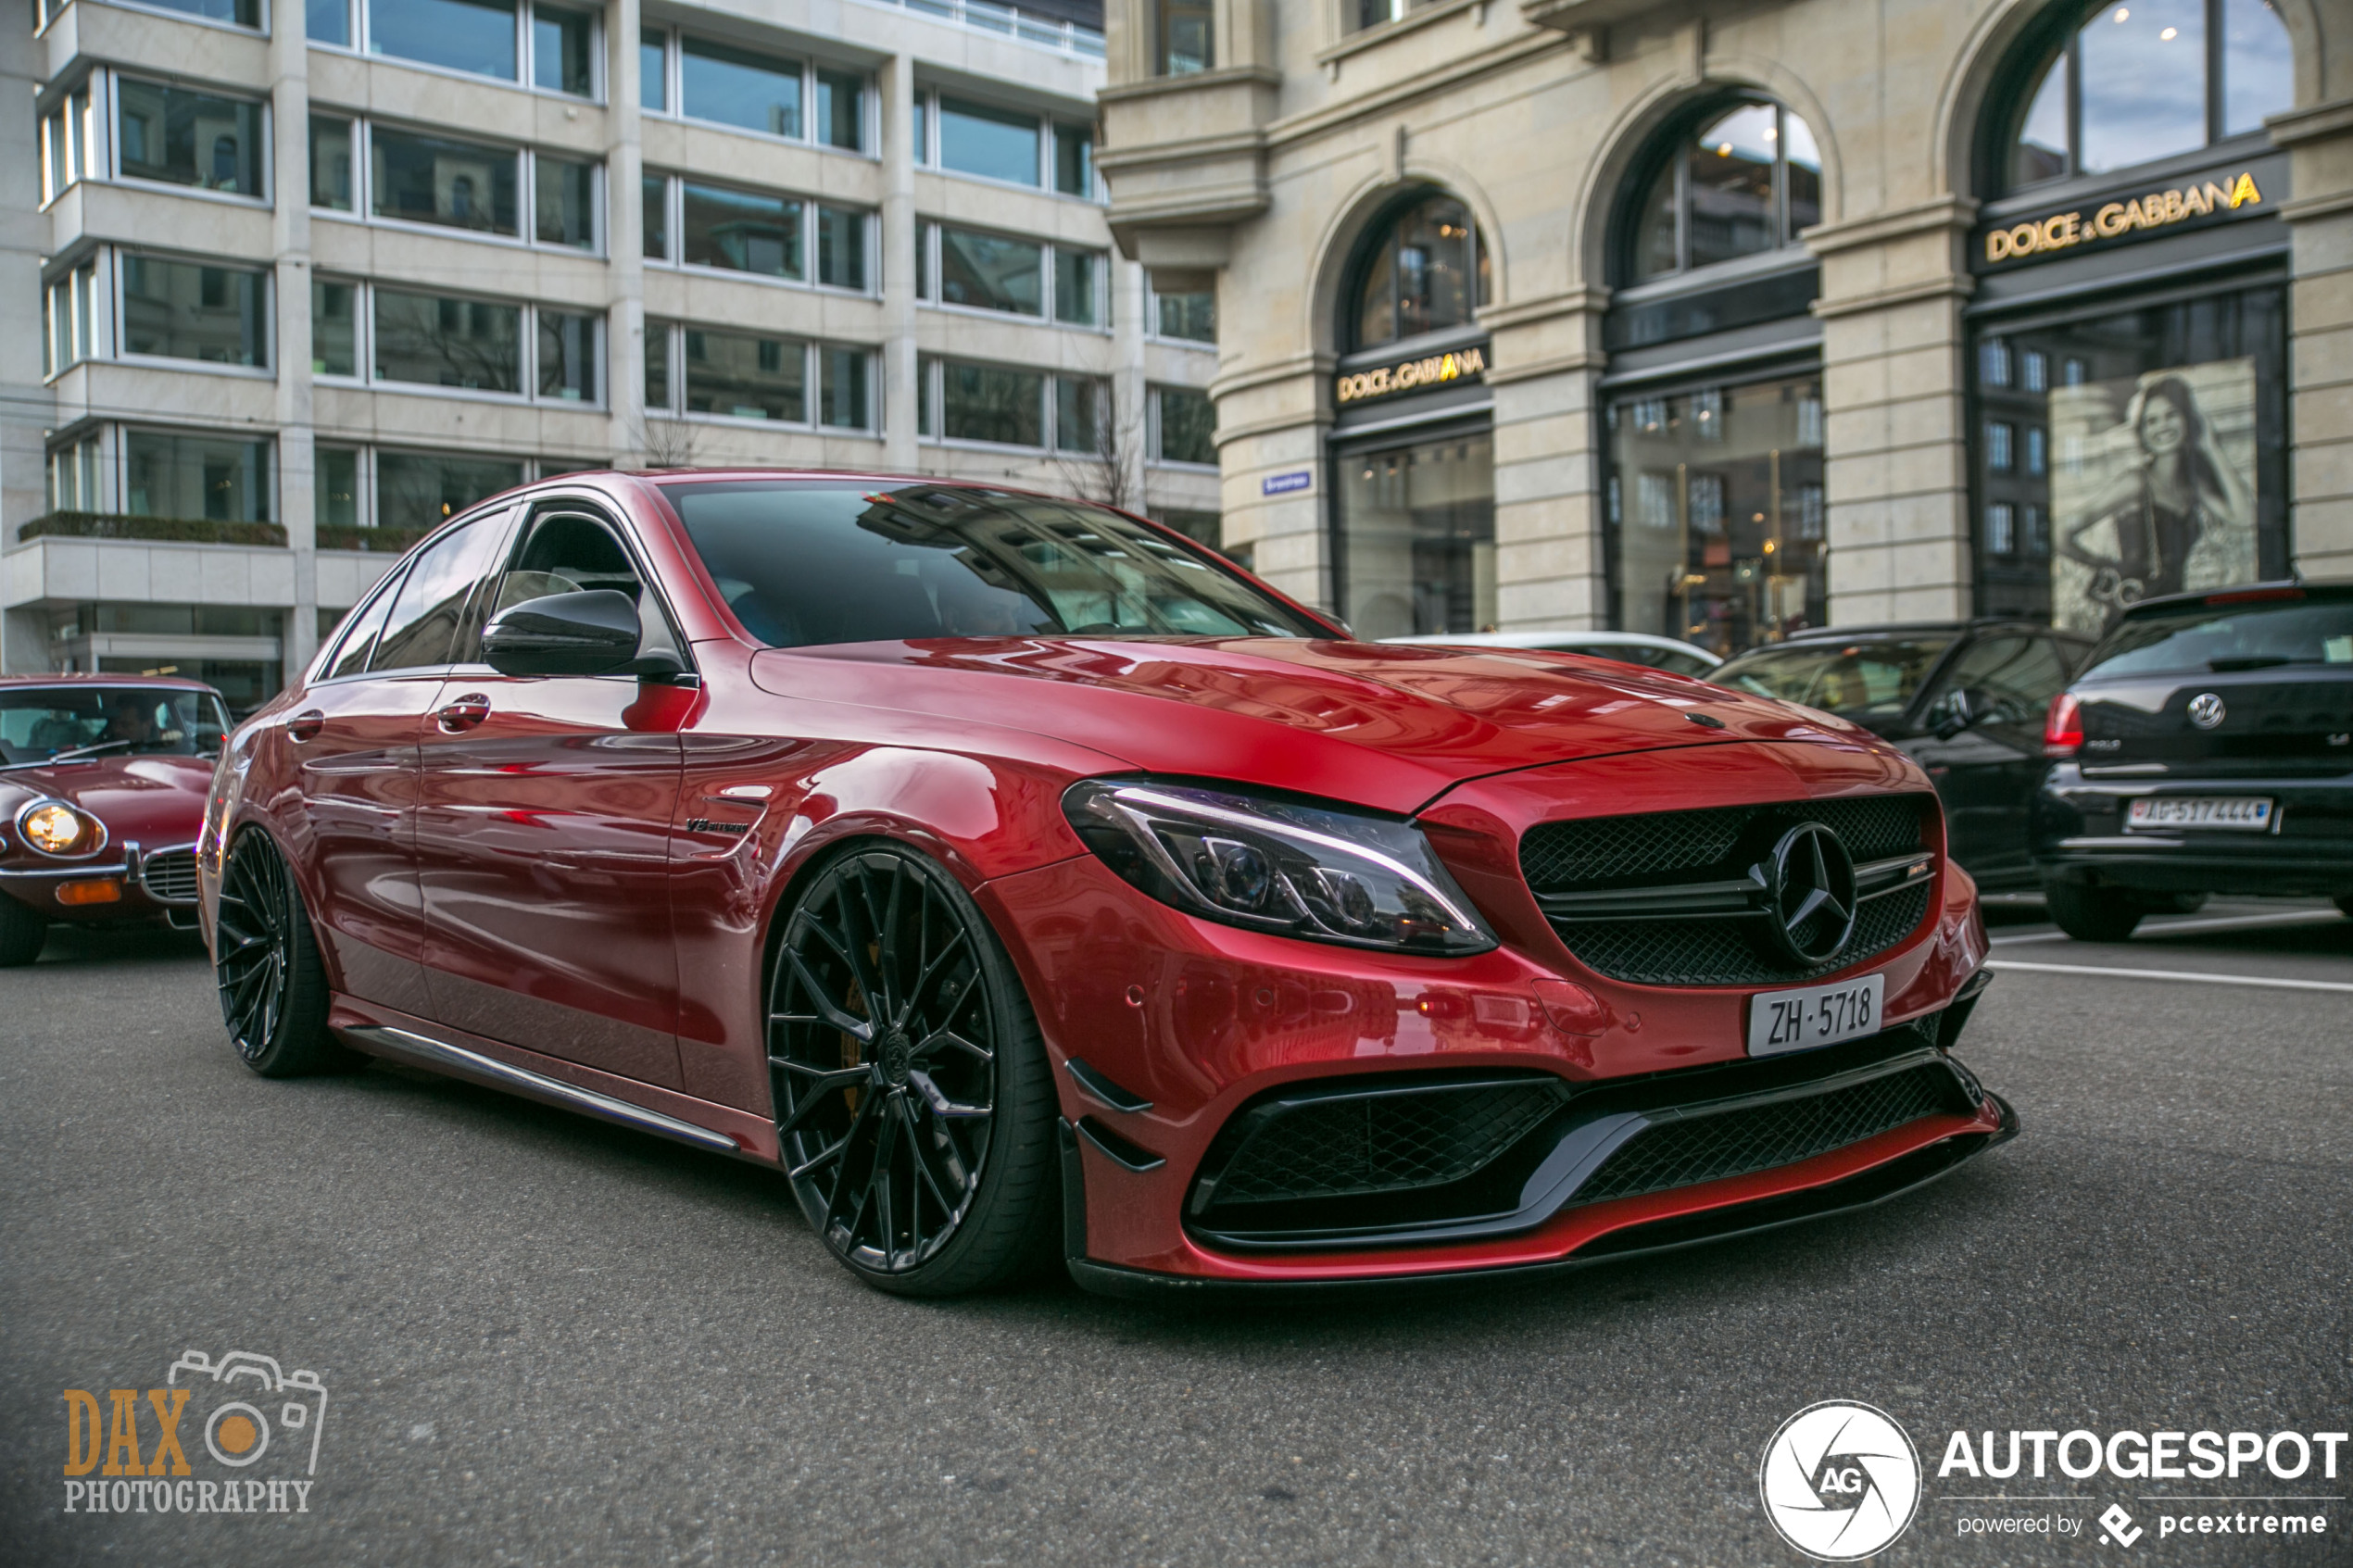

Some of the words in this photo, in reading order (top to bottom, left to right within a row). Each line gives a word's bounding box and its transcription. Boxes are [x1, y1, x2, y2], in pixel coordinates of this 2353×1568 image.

[1985, 211, 2081, 263] DOLCE
[2094, 172, 2262, 238] GABBANA
[1337, 367, 1390, 402] DOLCE
[686, 818, 709, 832] V8
